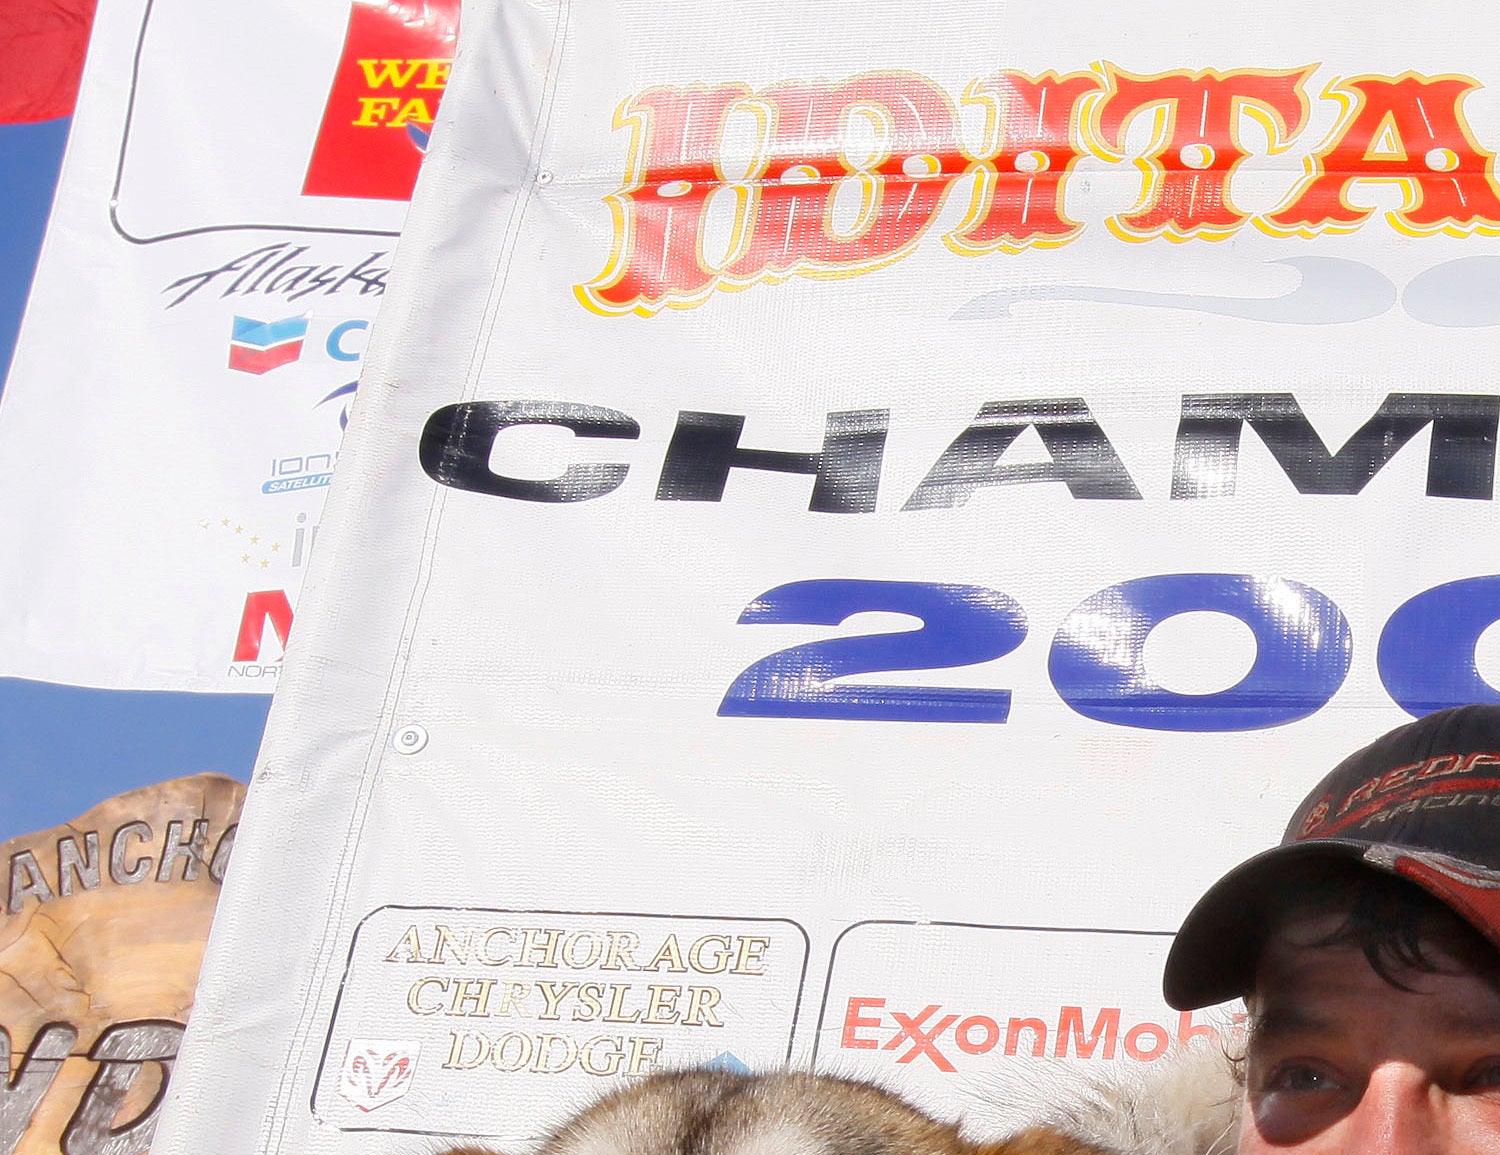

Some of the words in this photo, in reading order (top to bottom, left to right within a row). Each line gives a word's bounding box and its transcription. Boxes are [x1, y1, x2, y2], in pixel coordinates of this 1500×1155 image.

[271, 451, 339, 477] ION
[383, 924, 772, 977] ANCHORAGE
[406, 975, 726, 1029] CHRYSLER
[442, 1029, 665, 1078] DODGE
